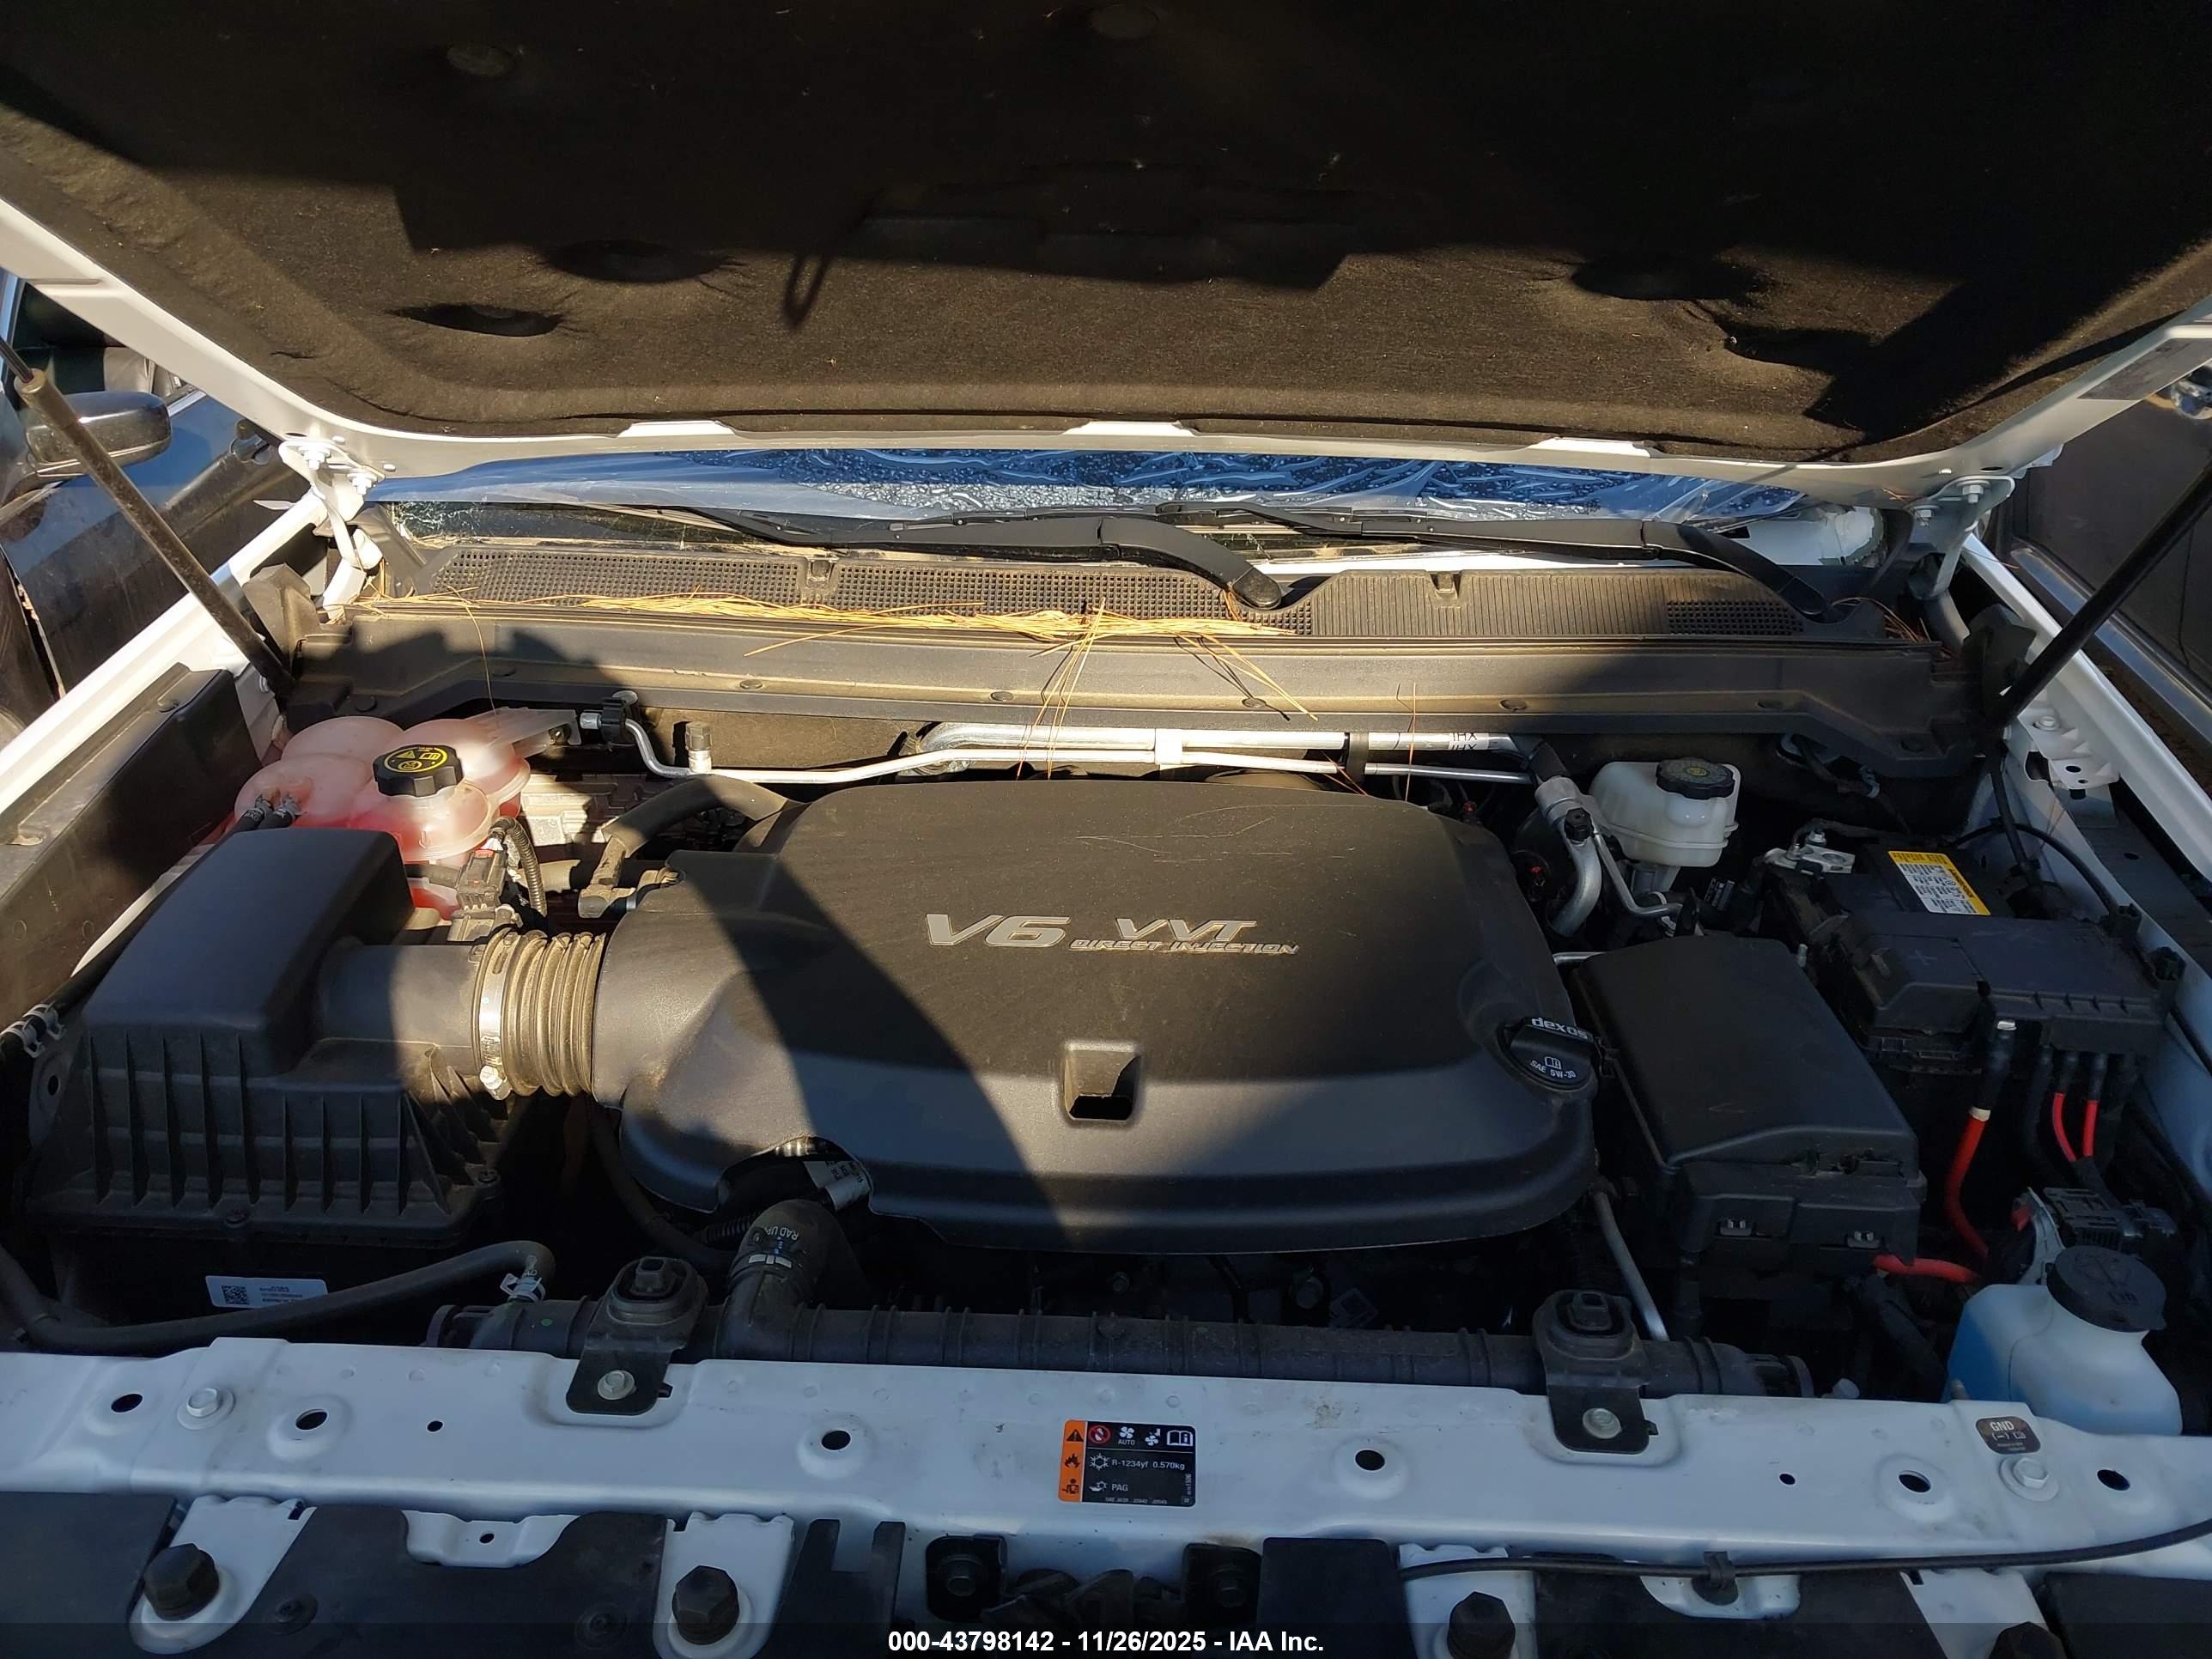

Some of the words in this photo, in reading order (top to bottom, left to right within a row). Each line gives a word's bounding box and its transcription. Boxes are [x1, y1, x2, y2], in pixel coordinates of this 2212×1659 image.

[926, 914, 1071, 948] V6
[1116, 918, 1258, 941] VVT
[1069, 939, 1163, 951] DIRECT
[1169, 940, 1300, 954] INJECTION
[1531, 1017, 1588, 1040] dexos
[1530, 1060, 1547, 1073] SAE
[1550, 1069, 1577, 1079] 5W-30
[780, 1227, 799, 1241] RAD
[1990, 1420, 2014, 1431] GND
[1112, 1460, 1149, 1469] R-1234yf
[1152, 1462, 1185, 1471] 0.570kg
[1111, 1483, 1128, 1492] PAG
